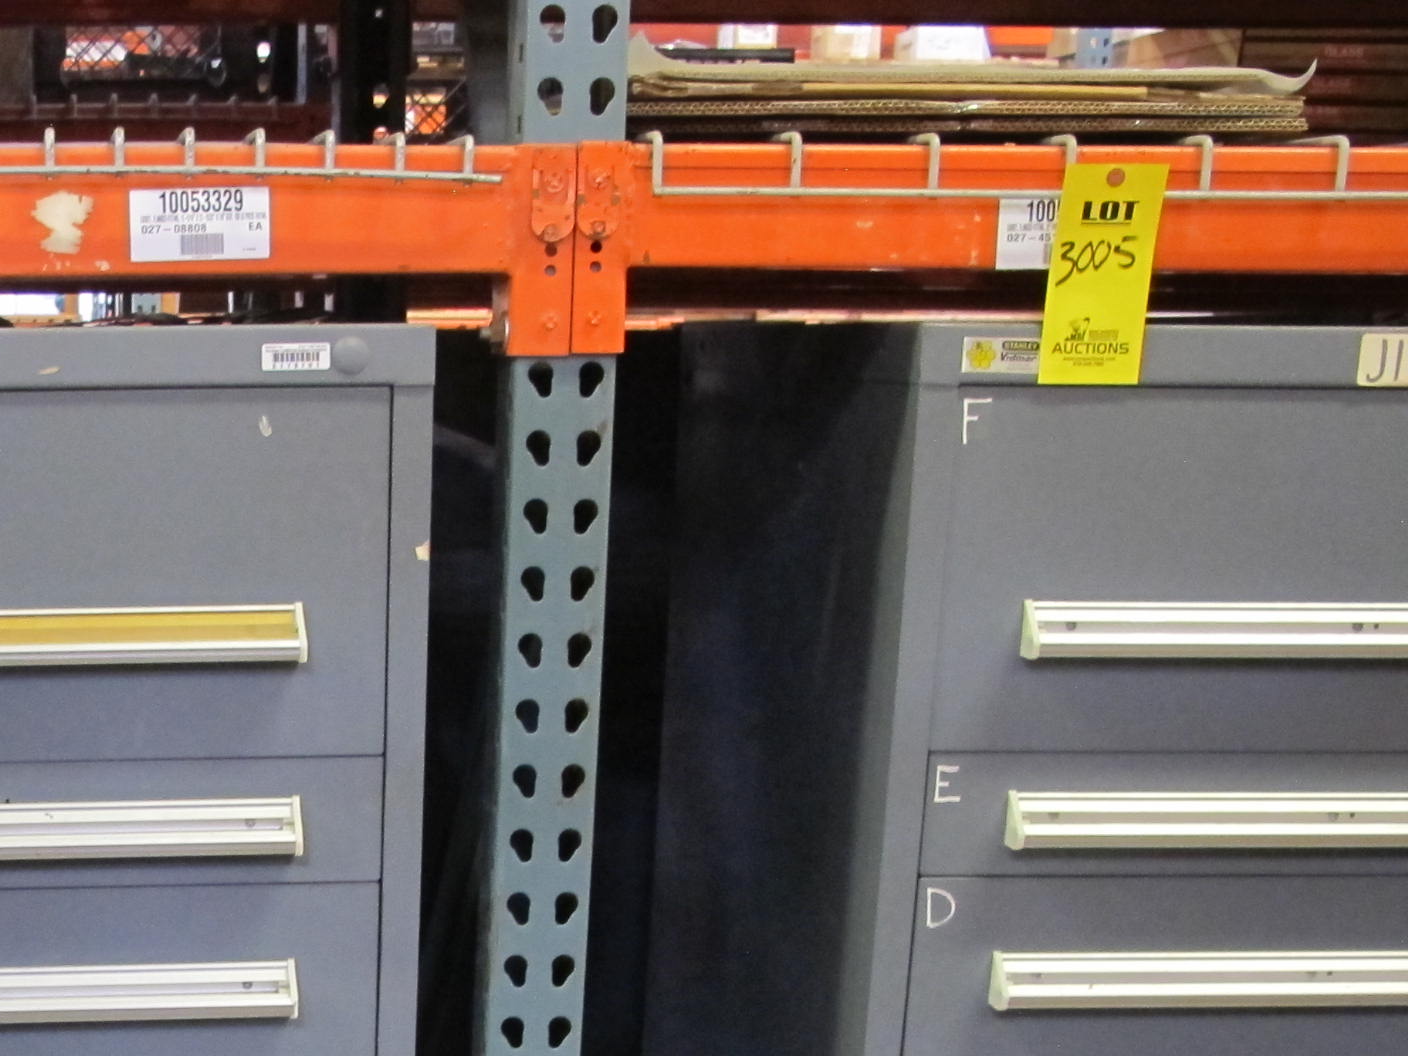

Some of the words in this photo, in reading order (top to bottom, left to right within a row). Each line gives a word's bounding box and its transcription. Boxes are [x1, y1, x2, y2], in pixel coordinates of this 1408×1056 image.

[159, 189, 244, 213] 10053329
[1026, 200, 1060, 222] 100
[1081, 200, 1140, 221] LOT
[248, 222, 263, 231] EA
[1055, 235, 1139, 287] 3005
[1051, 342, 1130, 354] AUCTIONS
[962, 397, 993, 445] F
[933, 765, 961, 803] E
[925, 887, 956, 929] D
